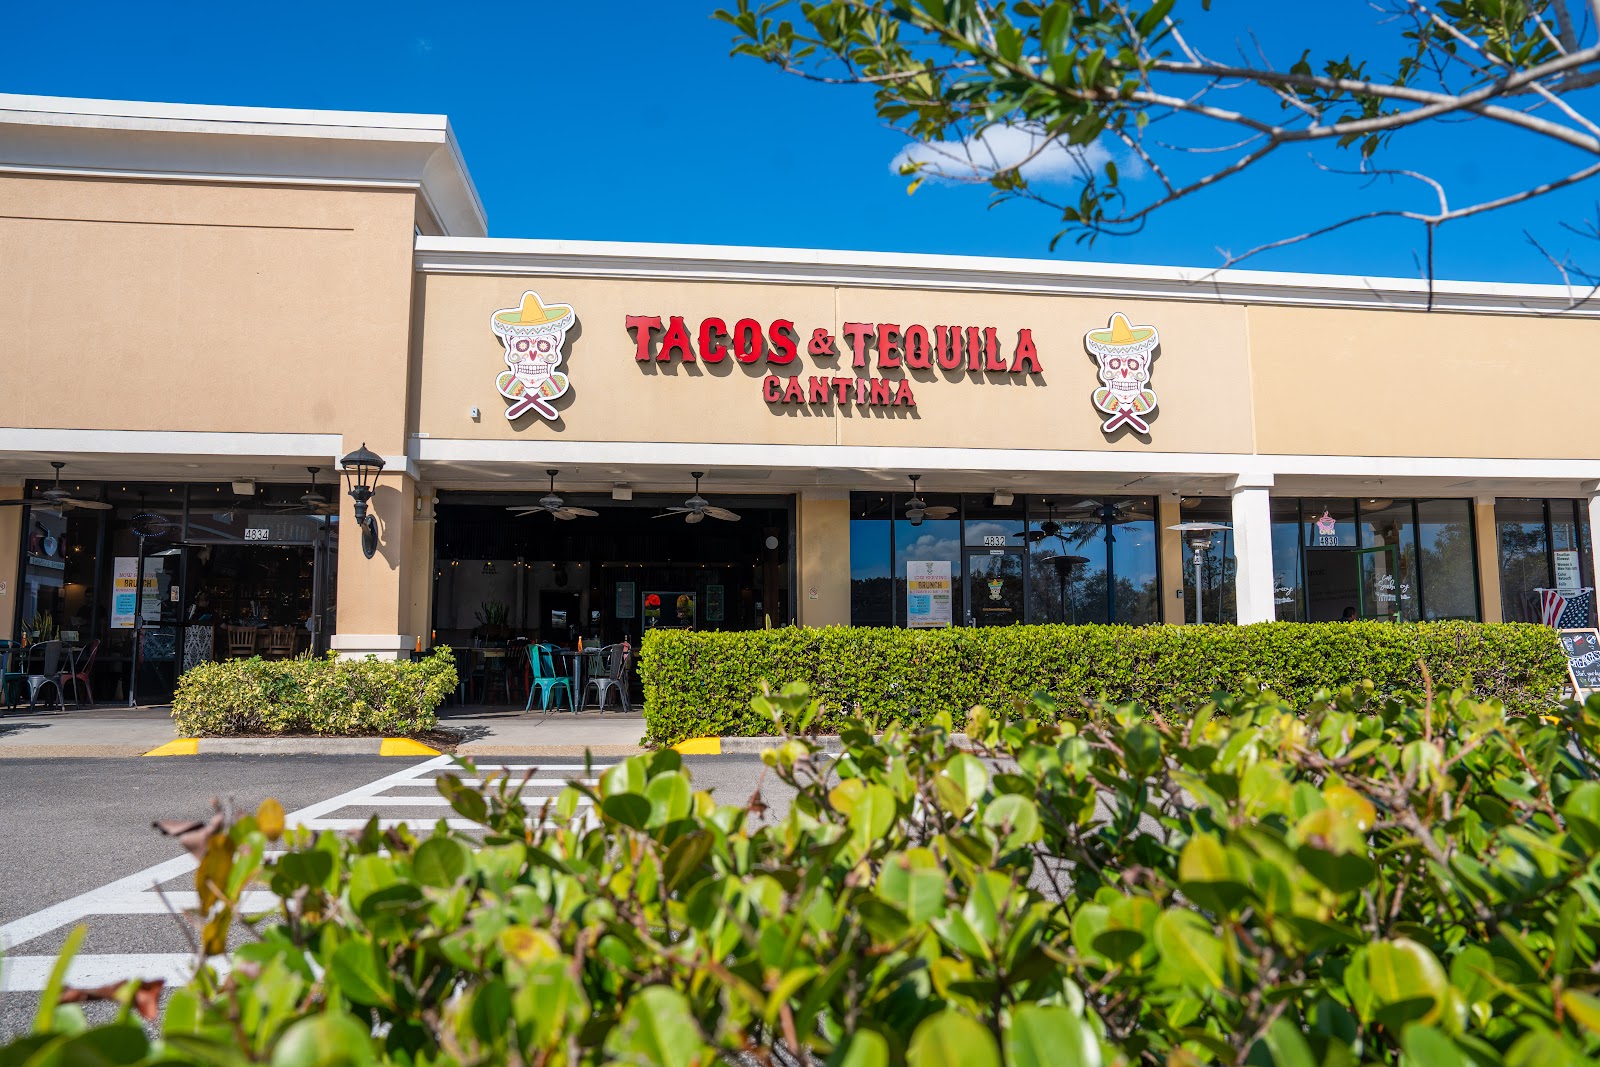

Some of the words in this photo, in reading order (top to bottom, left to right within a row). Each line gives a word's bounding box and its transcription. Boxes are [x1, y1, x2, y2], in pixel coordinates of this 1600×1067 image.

[626, 314, 798, 365] TACOS
[807, 327, 835, 356] &
[843, 321, 1044, 374] TEQUILA
[762, 374, 917, 407] CANTINA
[244, 528, 270, 541] 4834
[1320, 536, 1339, 546] 4830
[984, 536, 1005, 547] 4832
